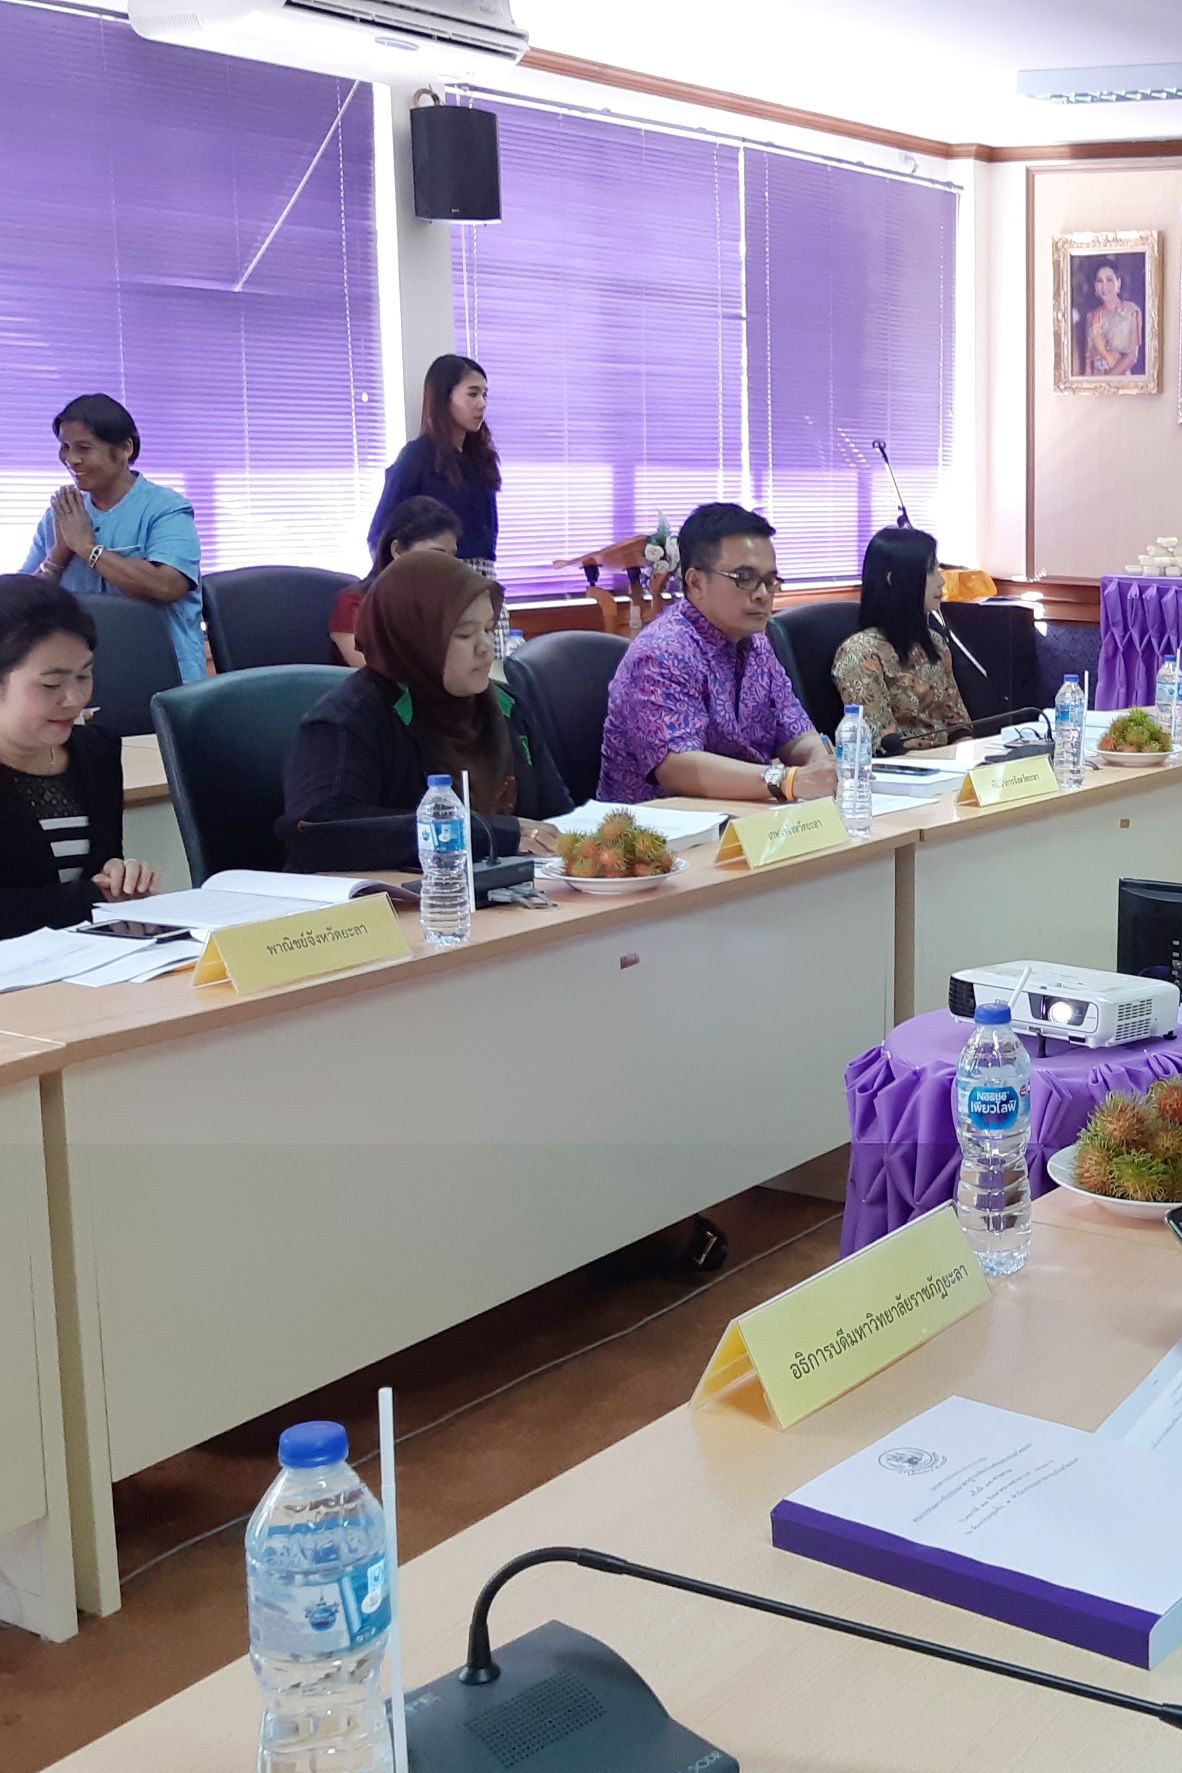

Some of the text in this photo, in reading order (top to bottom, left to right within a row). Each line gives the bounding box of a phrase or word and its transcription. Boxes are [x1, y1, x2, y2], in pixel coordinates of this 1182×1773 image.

[266, 923, 369, 956] พาณิชย์จังหวัดยะลา
[789, 1264, 969, 1380] อธิการบดีมหาวิทยาลัยราชภัฏยะลา
